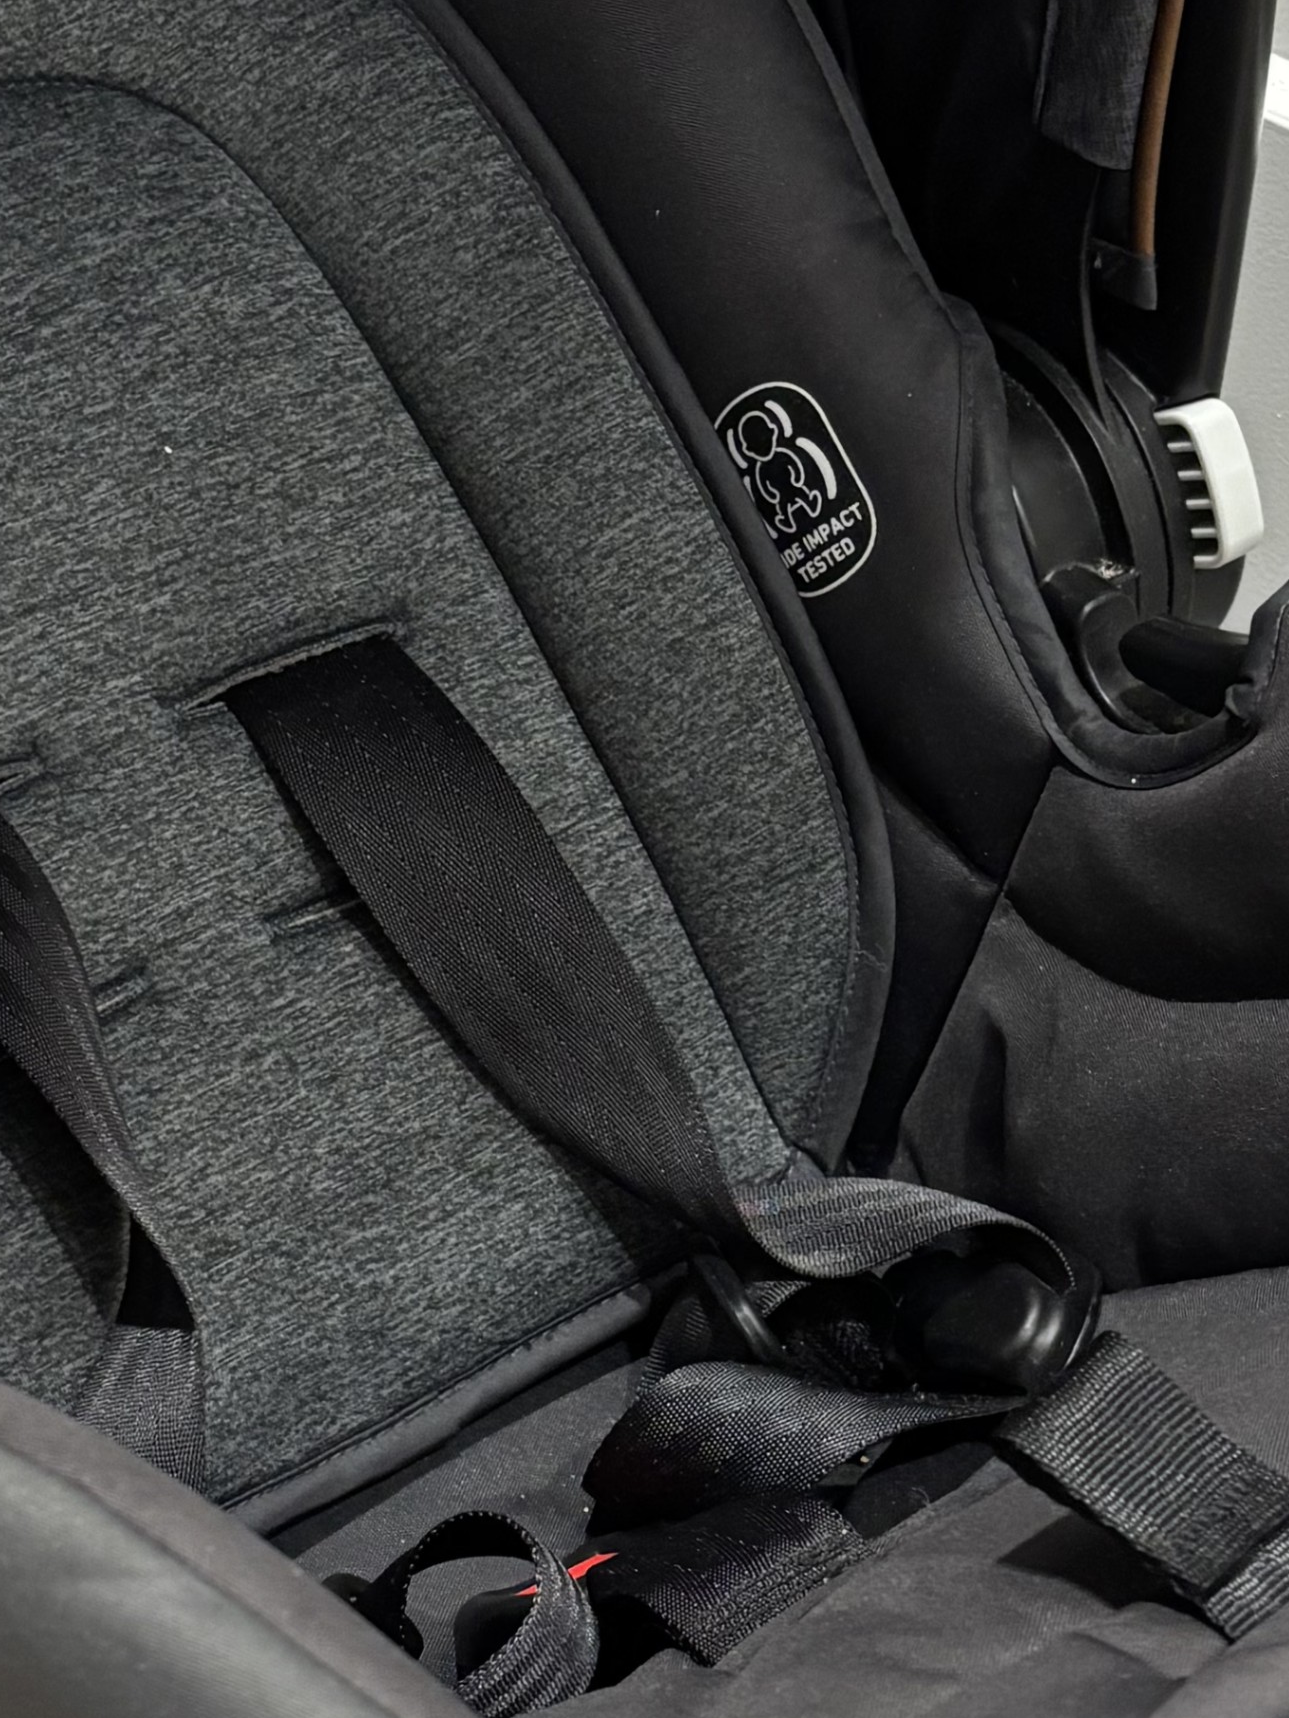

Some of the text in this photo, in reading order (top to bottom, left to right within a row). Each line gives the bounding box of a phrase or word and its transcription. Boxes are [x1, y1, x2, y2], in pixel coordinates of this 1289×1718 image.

[780, 502, 863, 569] IDE IMPACT
[797, 537, 856, 583] TESTED
